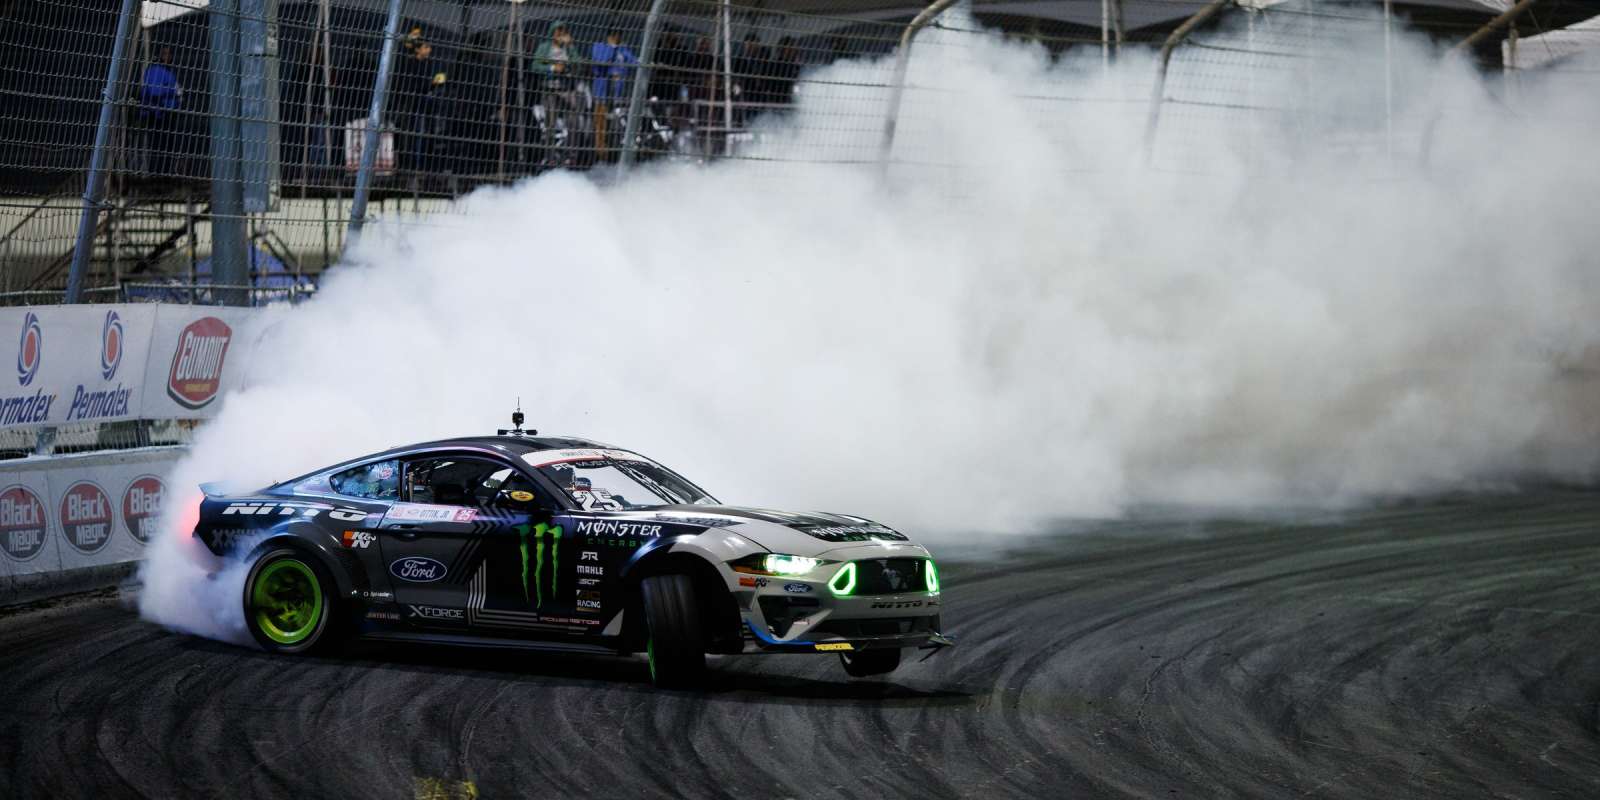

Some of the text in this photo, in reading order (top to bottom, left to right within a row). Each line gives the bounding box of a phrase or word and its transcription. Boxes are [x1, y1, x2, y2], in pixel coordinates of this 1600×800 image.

[0, 388, 56, 424] rmatex
[67, 383, 131, 420] Permatex
[1, 498, 39, 526] Black
[67, 492, 106, 521] Black
[223, 502, 369, 522] NITTO
[572, 489, 623, 512] 25
[8, 529, 41, 552] Magic
[75, 523, 107, 545] Magic
[401, 560, 436, 578] Ford
[577, 565, 604, 575] MAHLE
